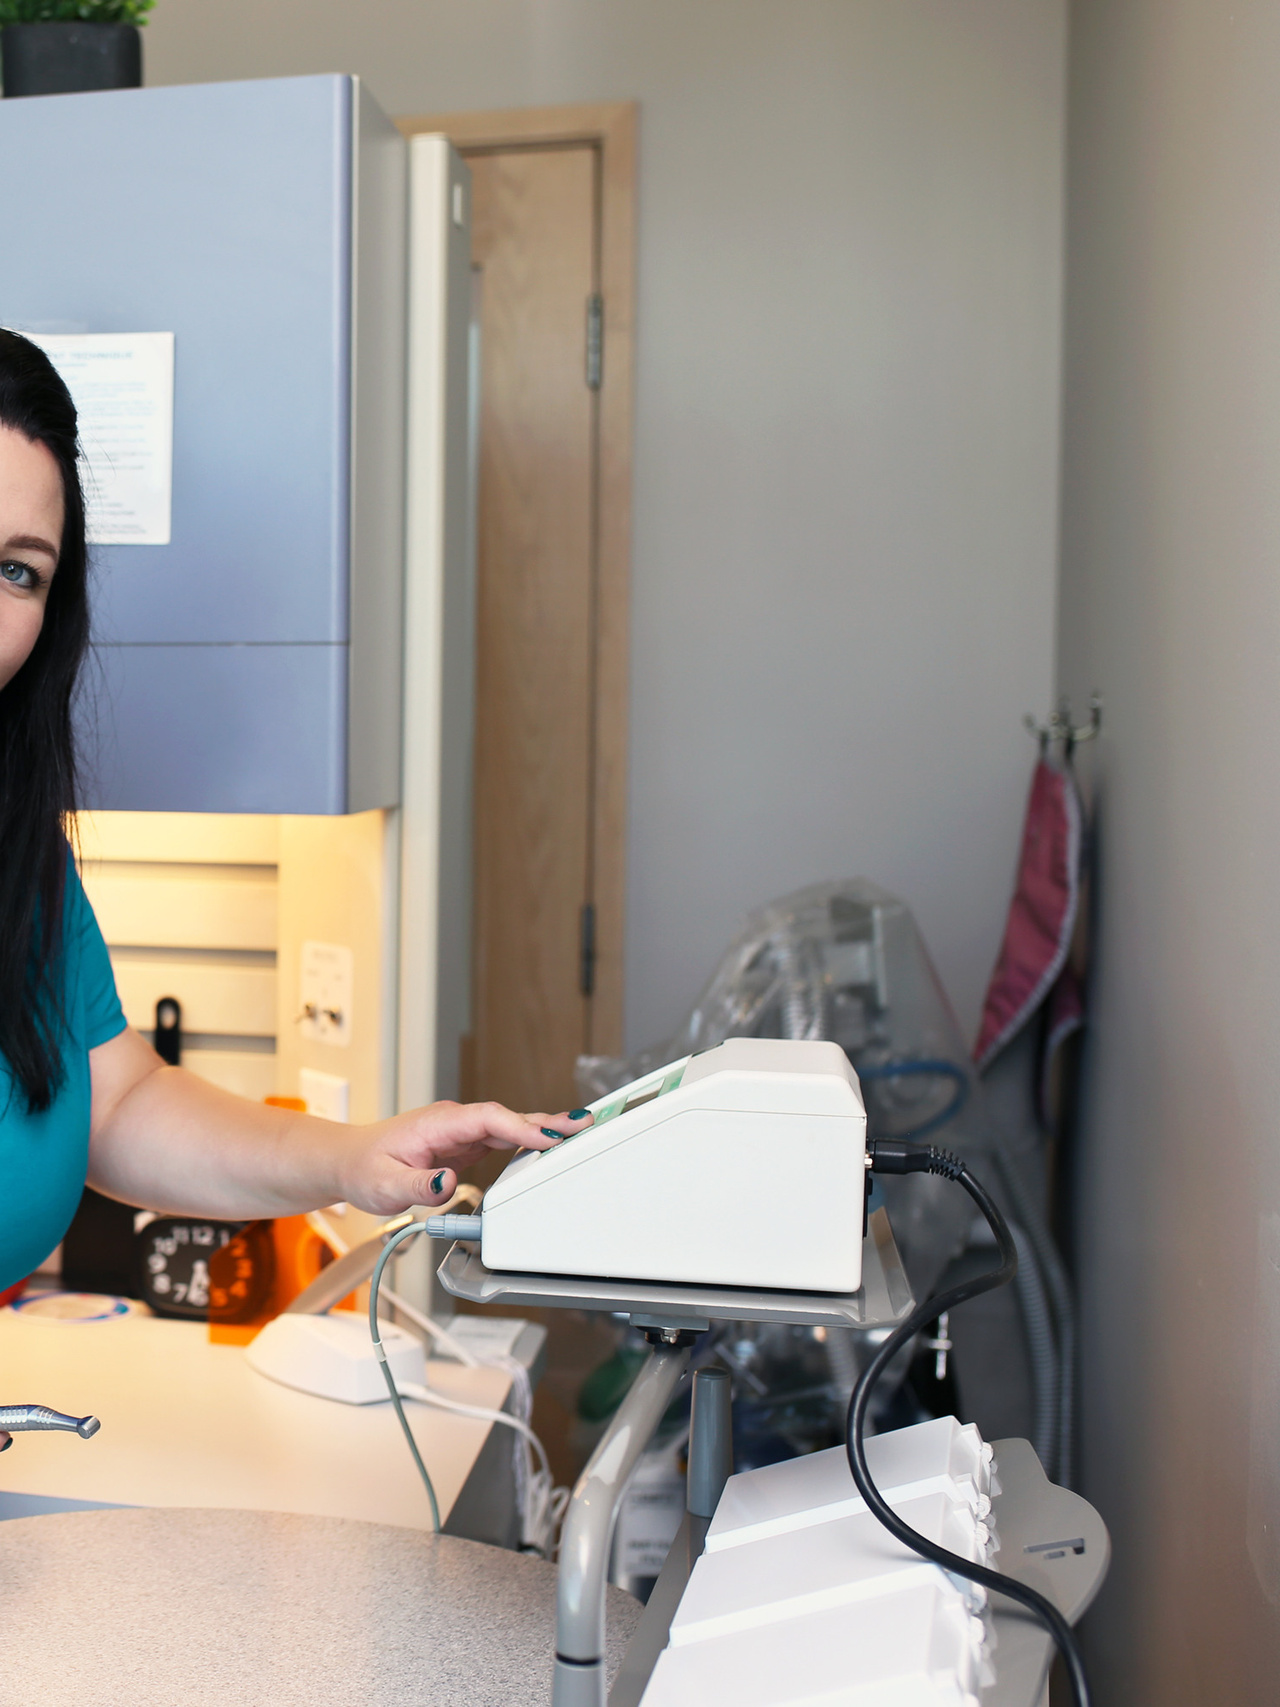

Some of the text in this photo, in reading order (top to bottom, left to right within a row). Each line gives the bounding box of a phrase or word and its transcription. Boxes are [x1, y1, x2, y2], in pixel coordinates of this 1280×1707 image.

[172, 1226, 189, 1245] 11
[192, 1226, 214, 1245] 12
[220, 1229, 230, 1247] 1
[154, 1237, 177, 1255] 10
[231, 1238, 246, 1257] 2
[148, 1253, 167, 1273] 9
[236, 1259, 252, 1279] 3
[153, 1274, 170, 1293] 8
[173, 1283, 187, 1303] 7
[230, 1280, 246, 1298] 4
